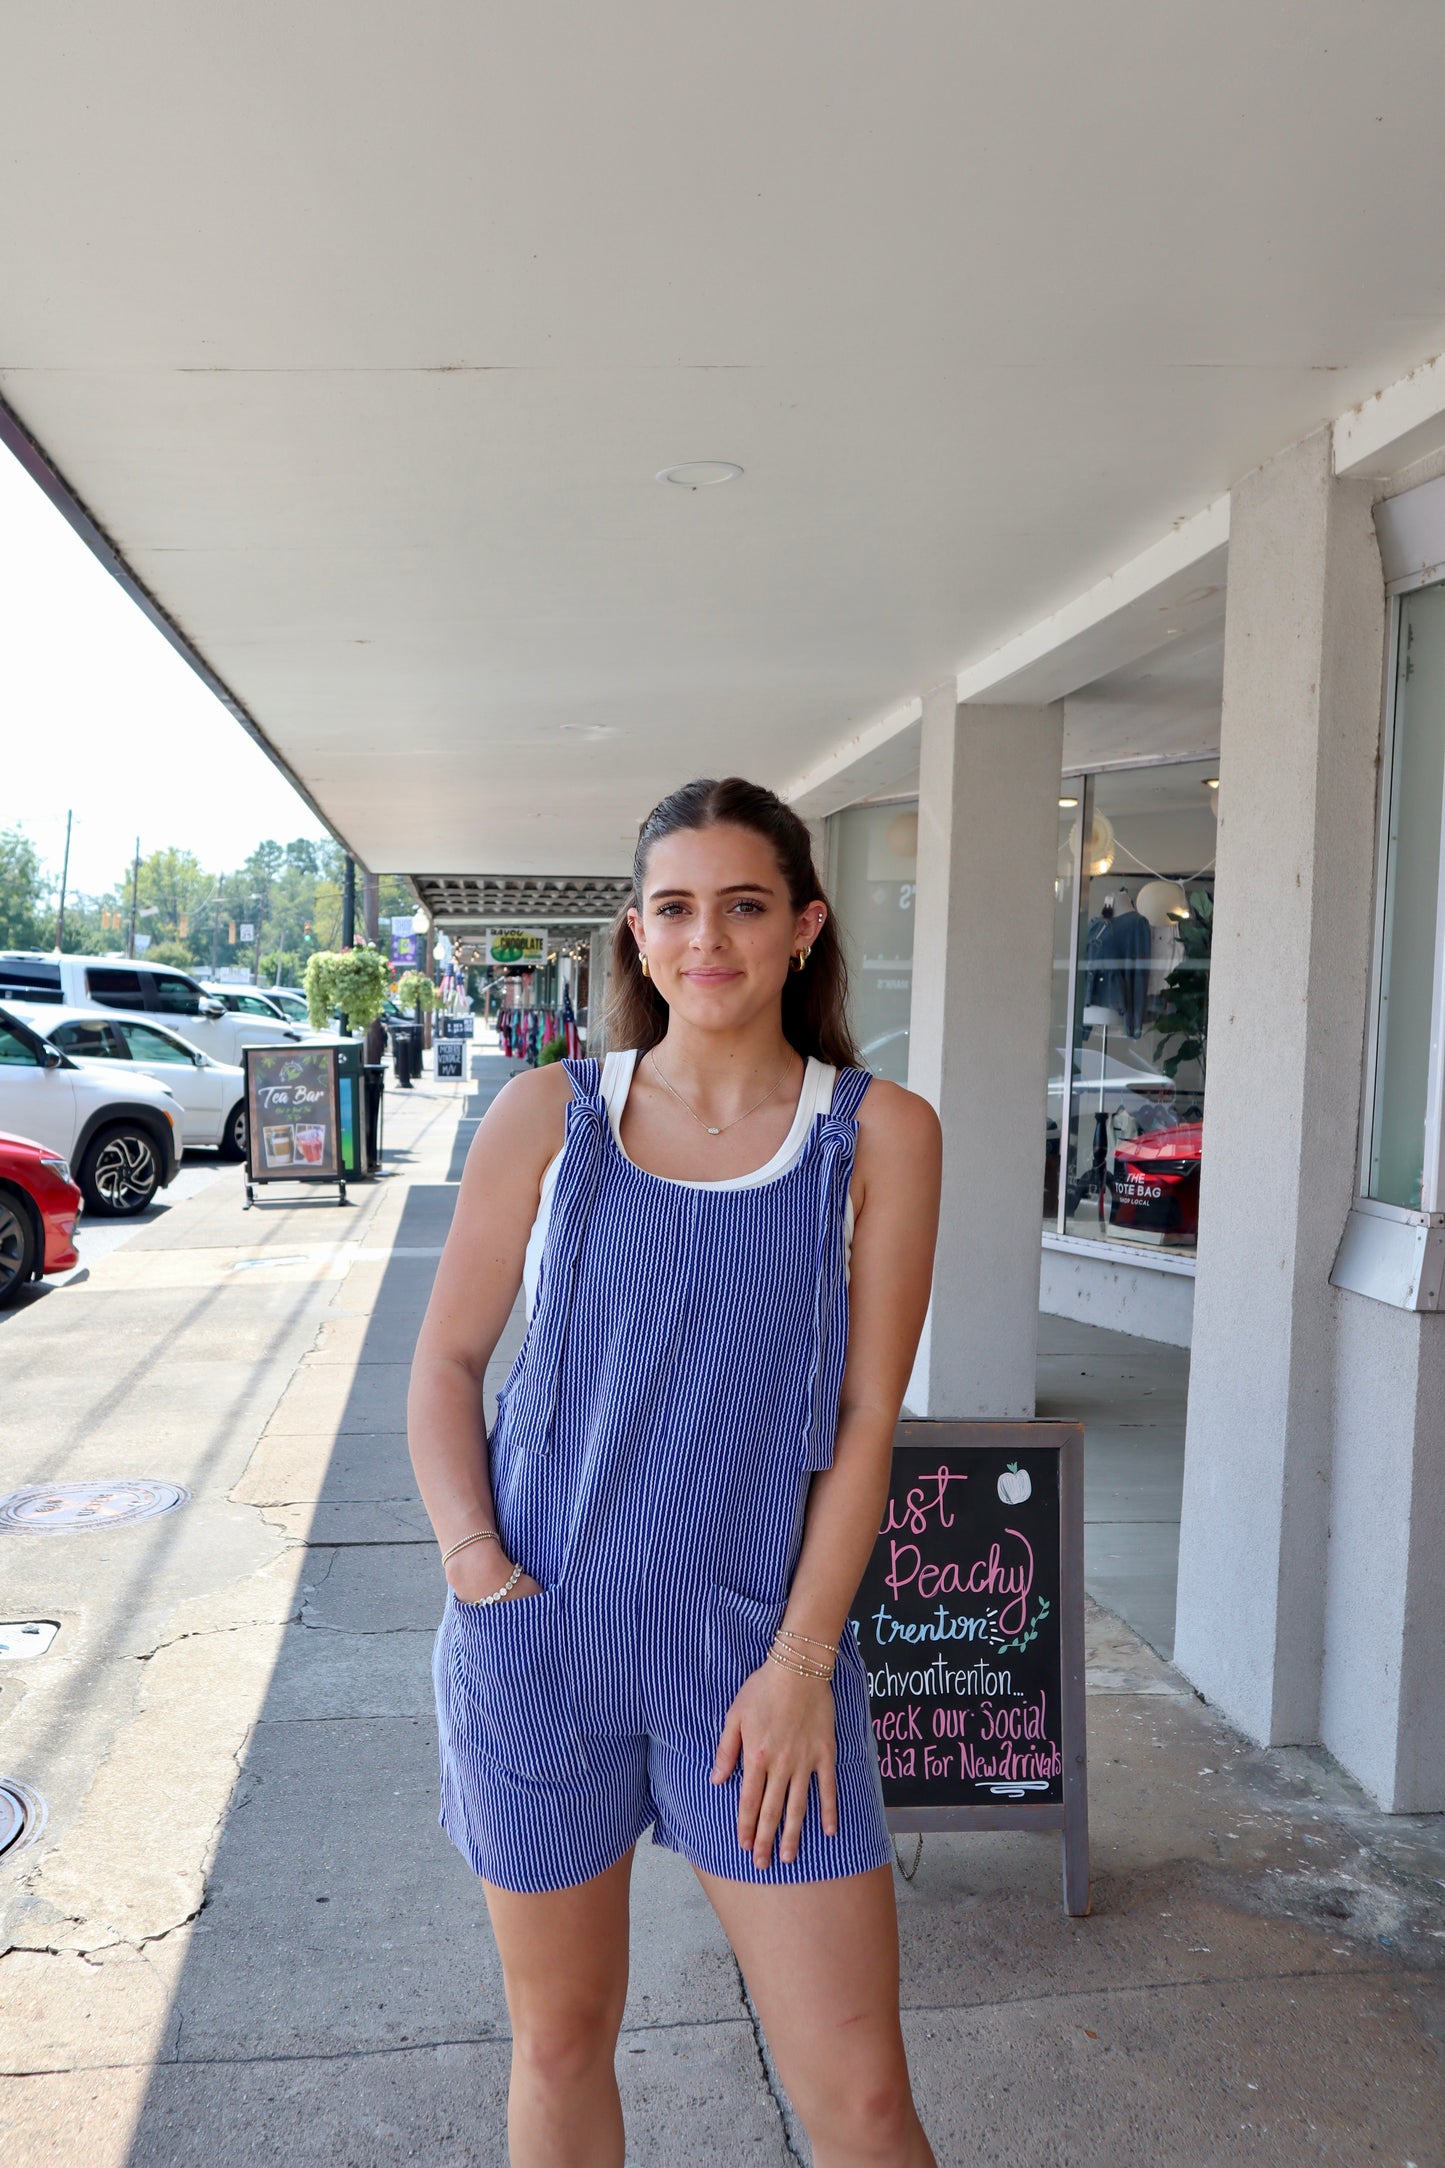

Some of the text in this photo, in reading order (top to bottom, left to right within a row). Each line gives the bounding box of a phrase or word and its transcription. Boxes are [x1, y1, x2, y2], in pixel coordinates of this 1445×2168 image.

[258, 1085, 324, 1109] Tea Bar
[1115, 1182, 1161, 1198] TOTE BAG
[1126, 1172, 1145, 1185] THE
[878, 1465, 968, 1535] ust
[884, 1528, 1034, 1635] Peachy
[871, 1603, 988, 1646] trenton
[867, 1652, 1024, 1697] achyontrenton...
[871, 1689, 1047, 1741] eck our Social
[877, 1743, 916, 1779] dia
[924, 1745, 954, 1780] For
